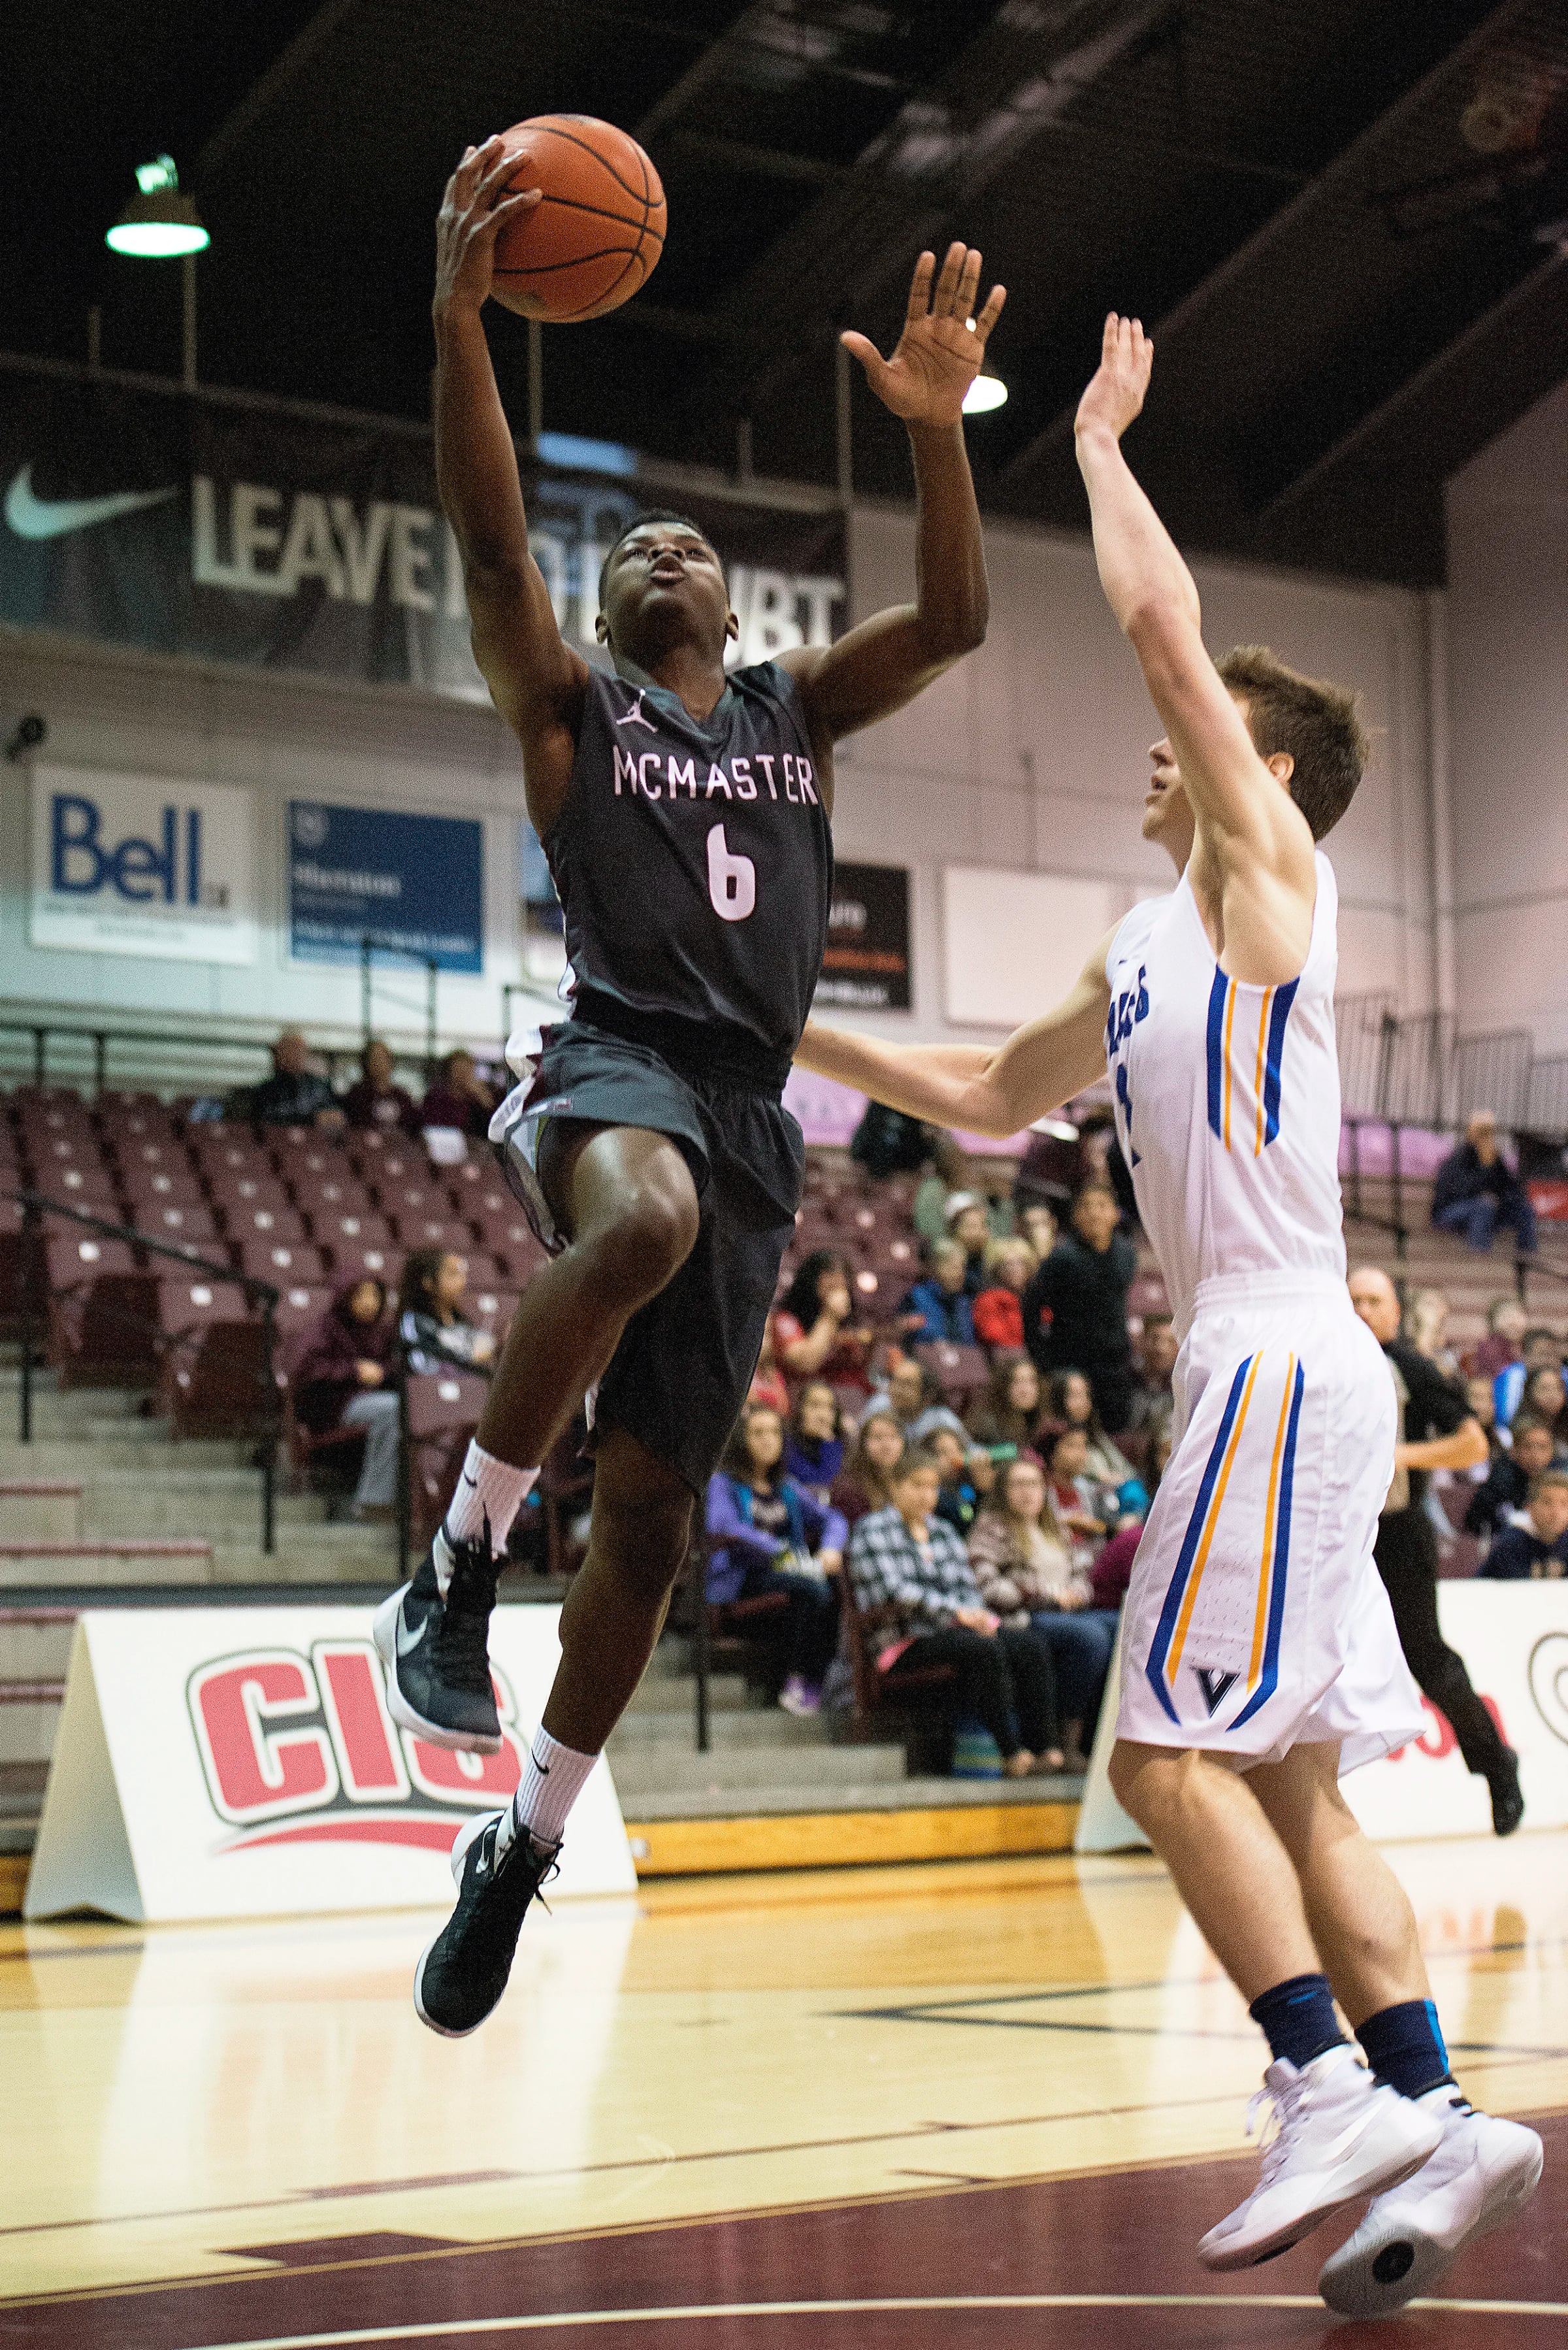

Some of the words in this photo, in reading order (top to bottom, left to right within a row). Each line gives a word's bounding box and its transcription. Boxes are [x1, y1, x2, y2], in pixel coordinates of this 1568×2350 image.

[191, 474, 435, 611] LEAVE
[613, 745, 819, 805] MCMASTER
[50, 793, 202, 908] Bell
[706, 823, 756, 921] 6
